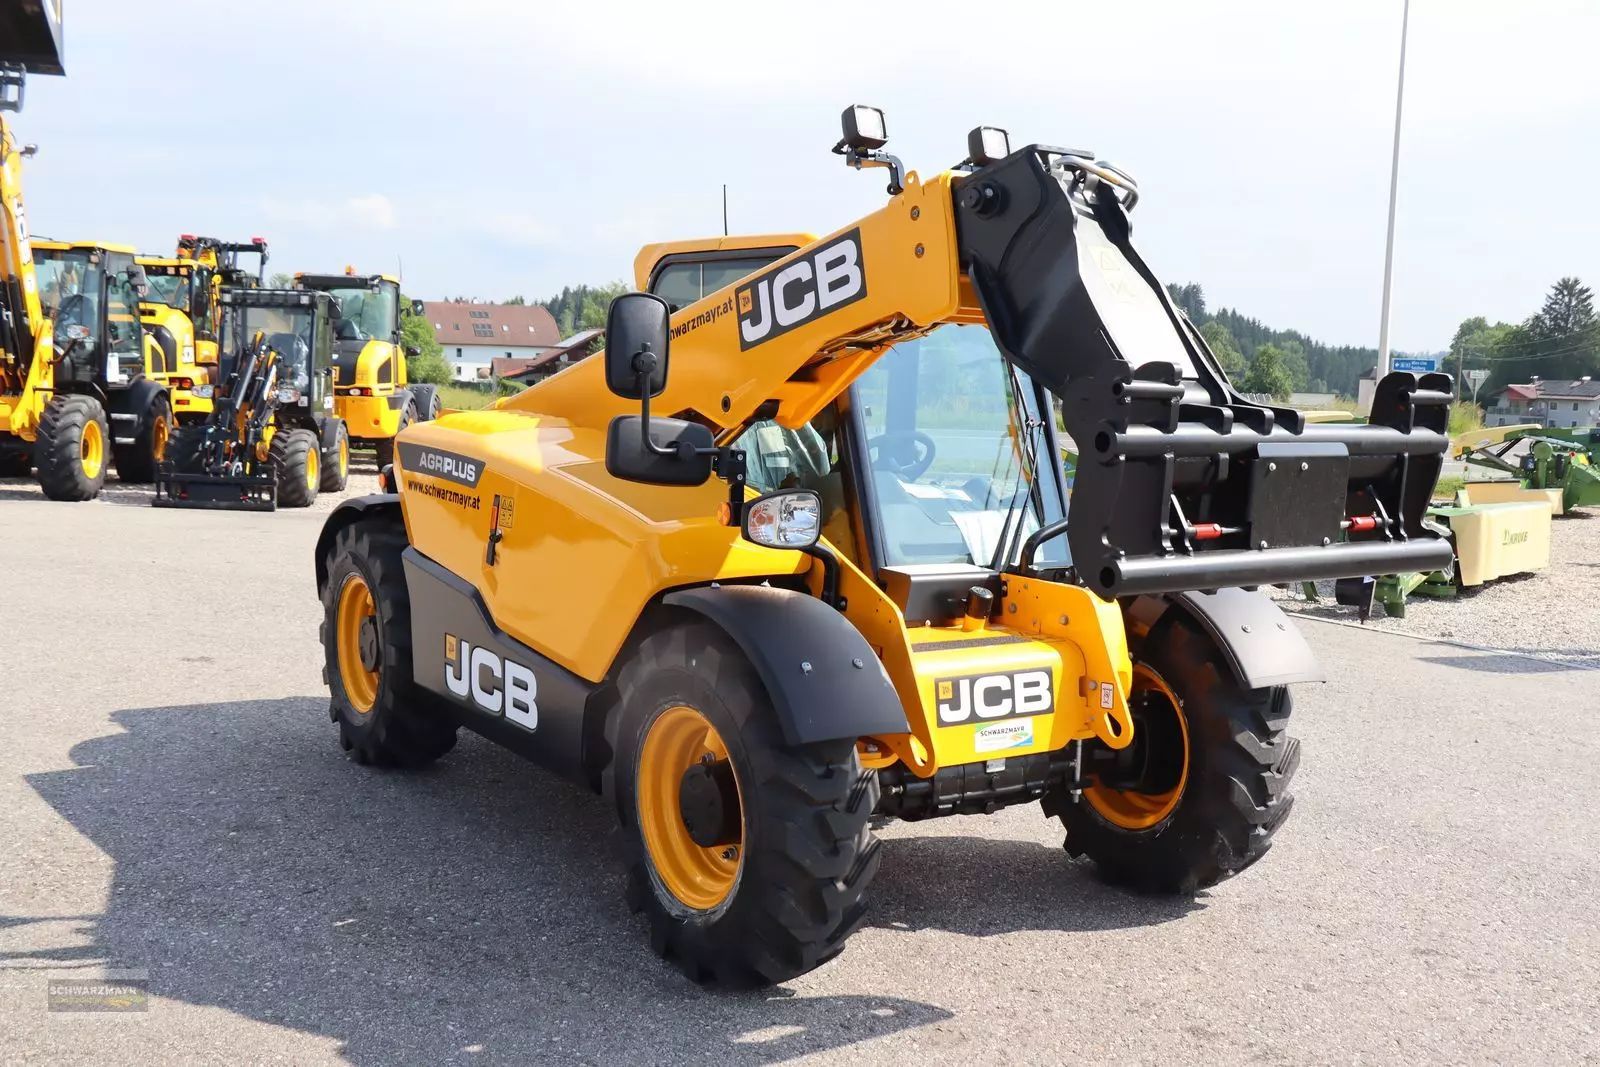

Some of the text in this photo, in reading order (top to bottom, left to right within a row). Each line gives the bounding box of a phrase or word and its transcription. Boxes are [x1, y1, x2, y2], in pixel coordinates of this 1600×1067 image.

[741, 239, 862, 342] JCB
[408, 480, 481, 510] www.schwarzmayr.at
[446, 640, 538, 730] JCB
[939, 671, 1052, 723] JCB
[980, 726, 1025, 737] SCHWARZMAYR
